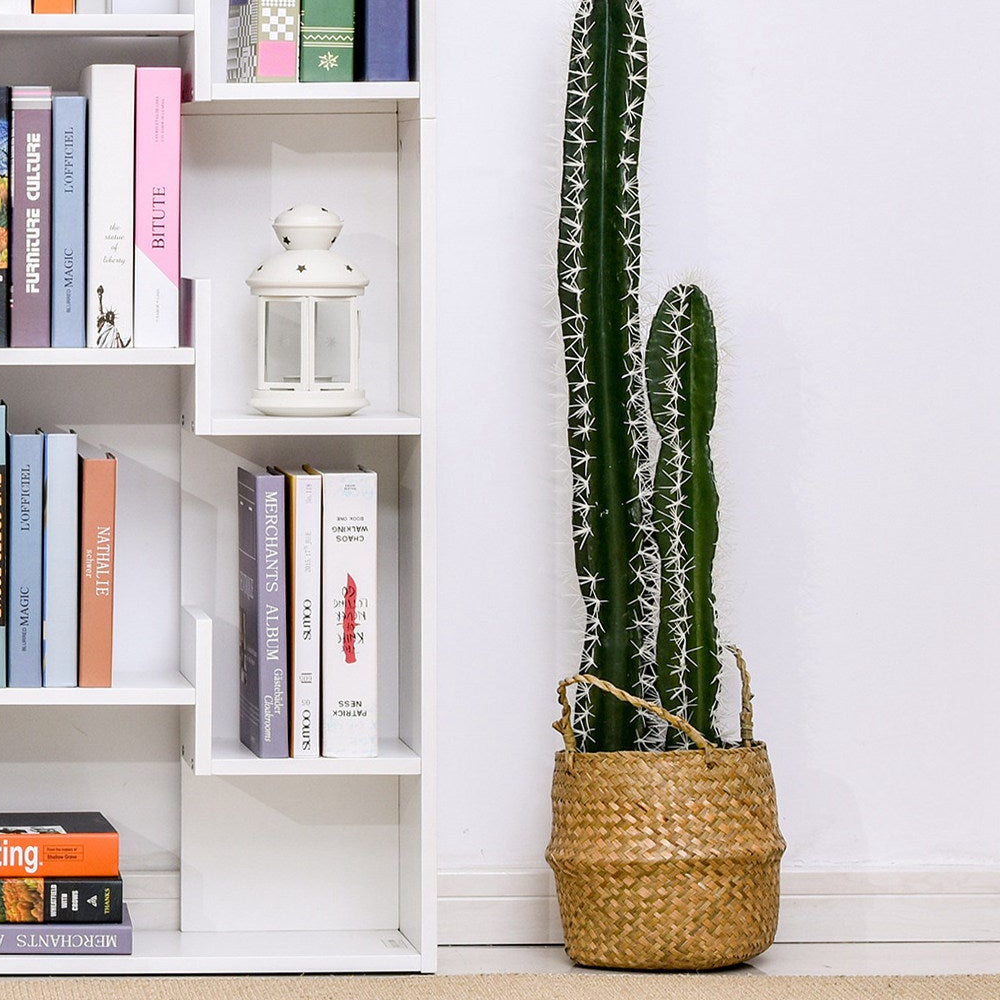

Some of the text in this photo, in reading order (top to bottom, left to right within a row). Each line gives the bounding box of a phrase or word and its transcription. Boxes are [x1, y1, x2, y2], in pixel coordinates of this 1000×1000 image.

[65, 127, 74, 193] L'OFFICIEL
[26, 133, 41, 293] FURNITURE CULTURE
[152, 186, 166, 249] BITUTE
[65, 248, 74, 288] MAGIC
[21, 464, 30, 531] L'OFFICIEL
[96, 526, 110, 596] NATHALIE
[265, 491, 280, 661] MERCHANTS ALBUM
[20, 586, 30, 626] MAGIC
[264, 694, 273, 742] Cloakrooms
[332, 709, 367, 717] PATRICK
[338, 700, 362, 708] NESS
[17, 934, 118, 947] MERCHANTS
